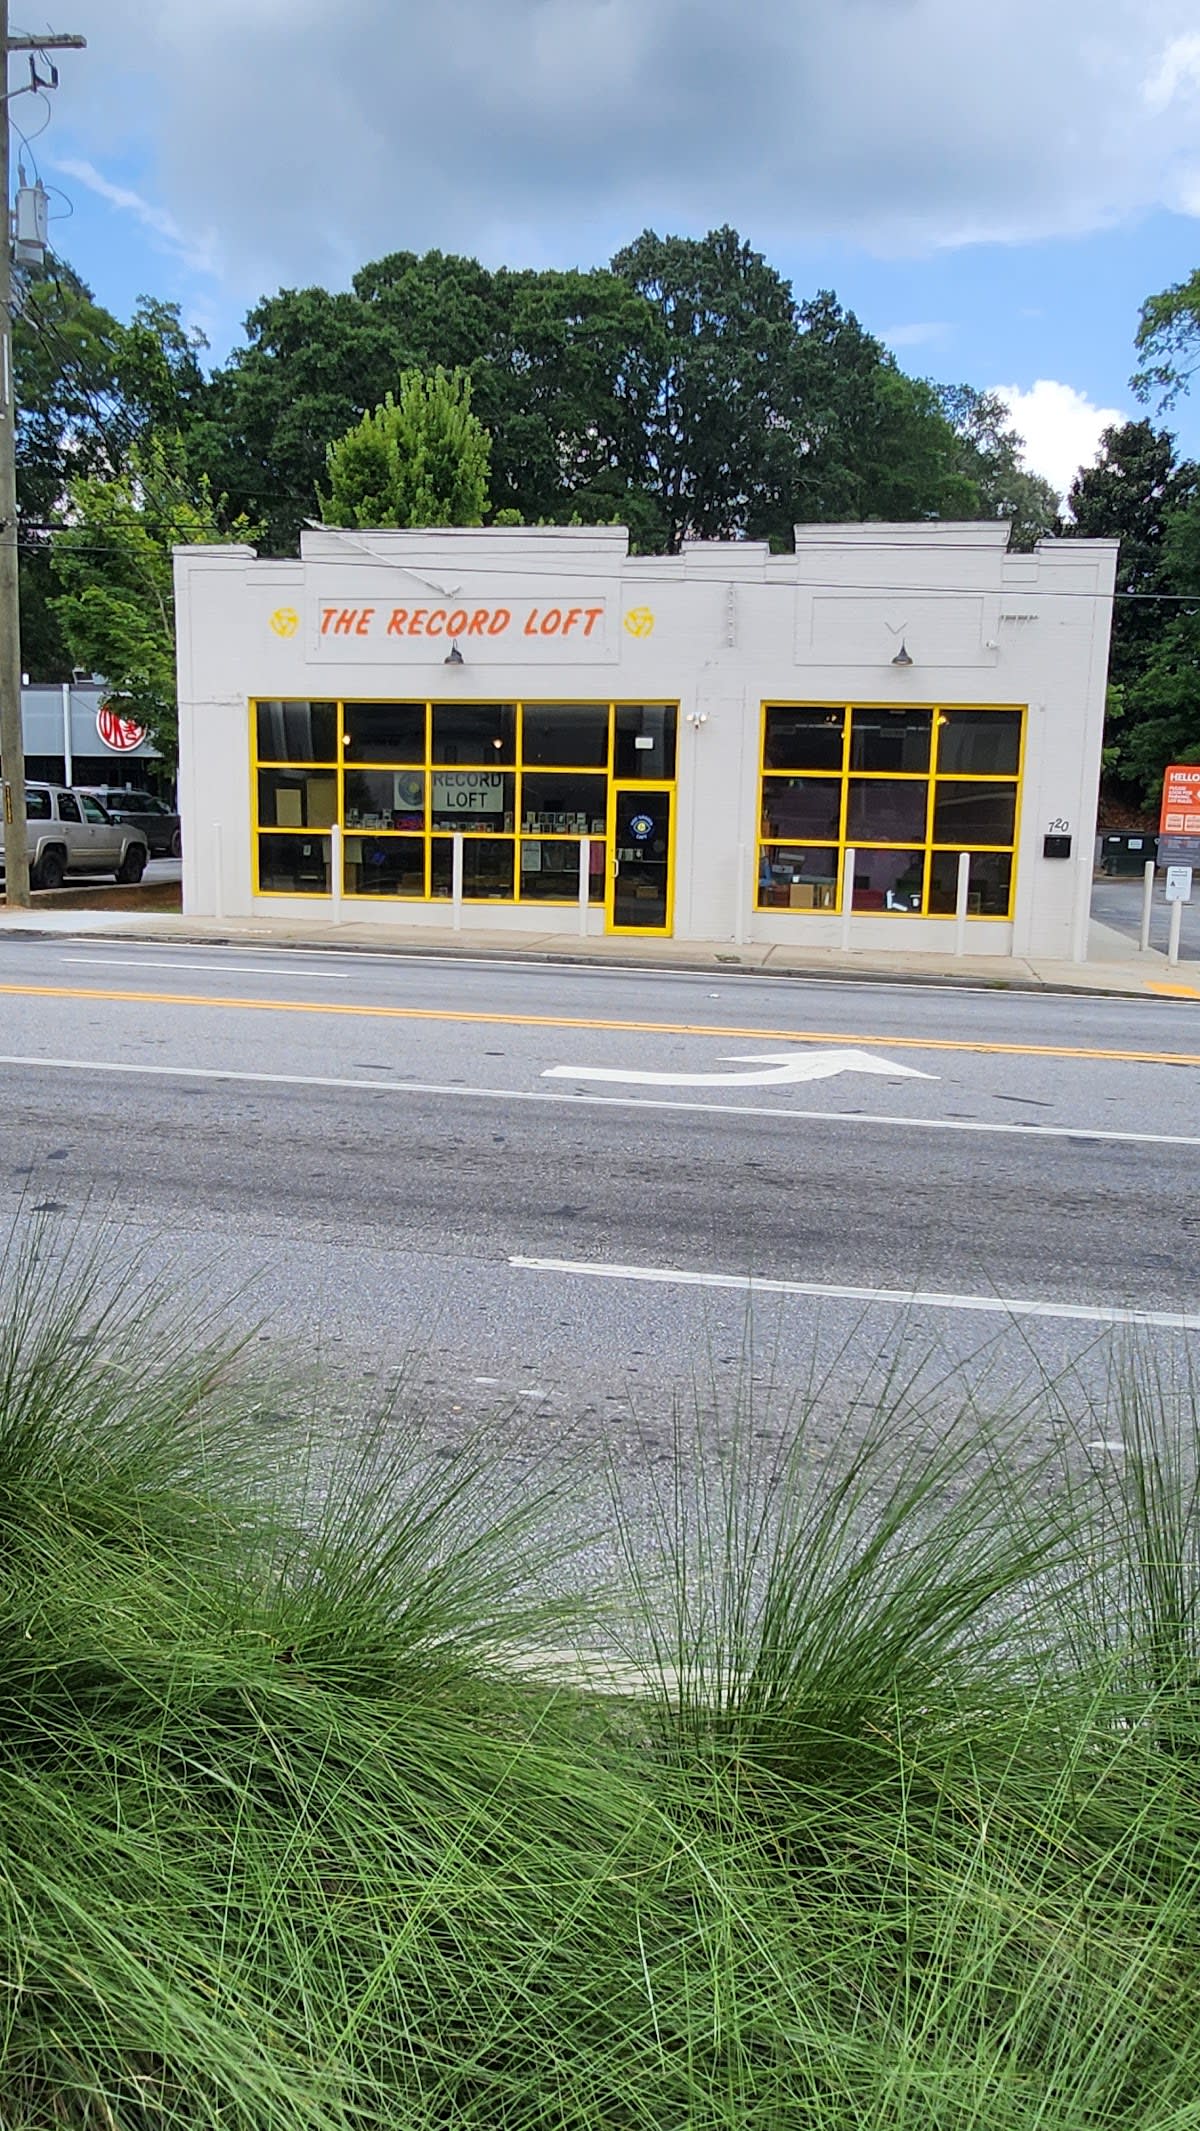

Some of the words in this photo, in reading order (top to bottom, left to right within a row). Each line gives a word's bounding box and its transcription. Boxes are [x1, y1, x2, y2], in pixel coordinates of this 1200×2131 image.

[321, 609, 375, 635] THE
[387, 609, 511, 637] RECORD
[524, 609, 604, 636] LOFT
[433, 773, 502, 788] RECORD
[1170, 772, 1200, 782] HELLO
[446, 792, 488, 807] LOFT
[1048, 817, 1070, 832] 720
